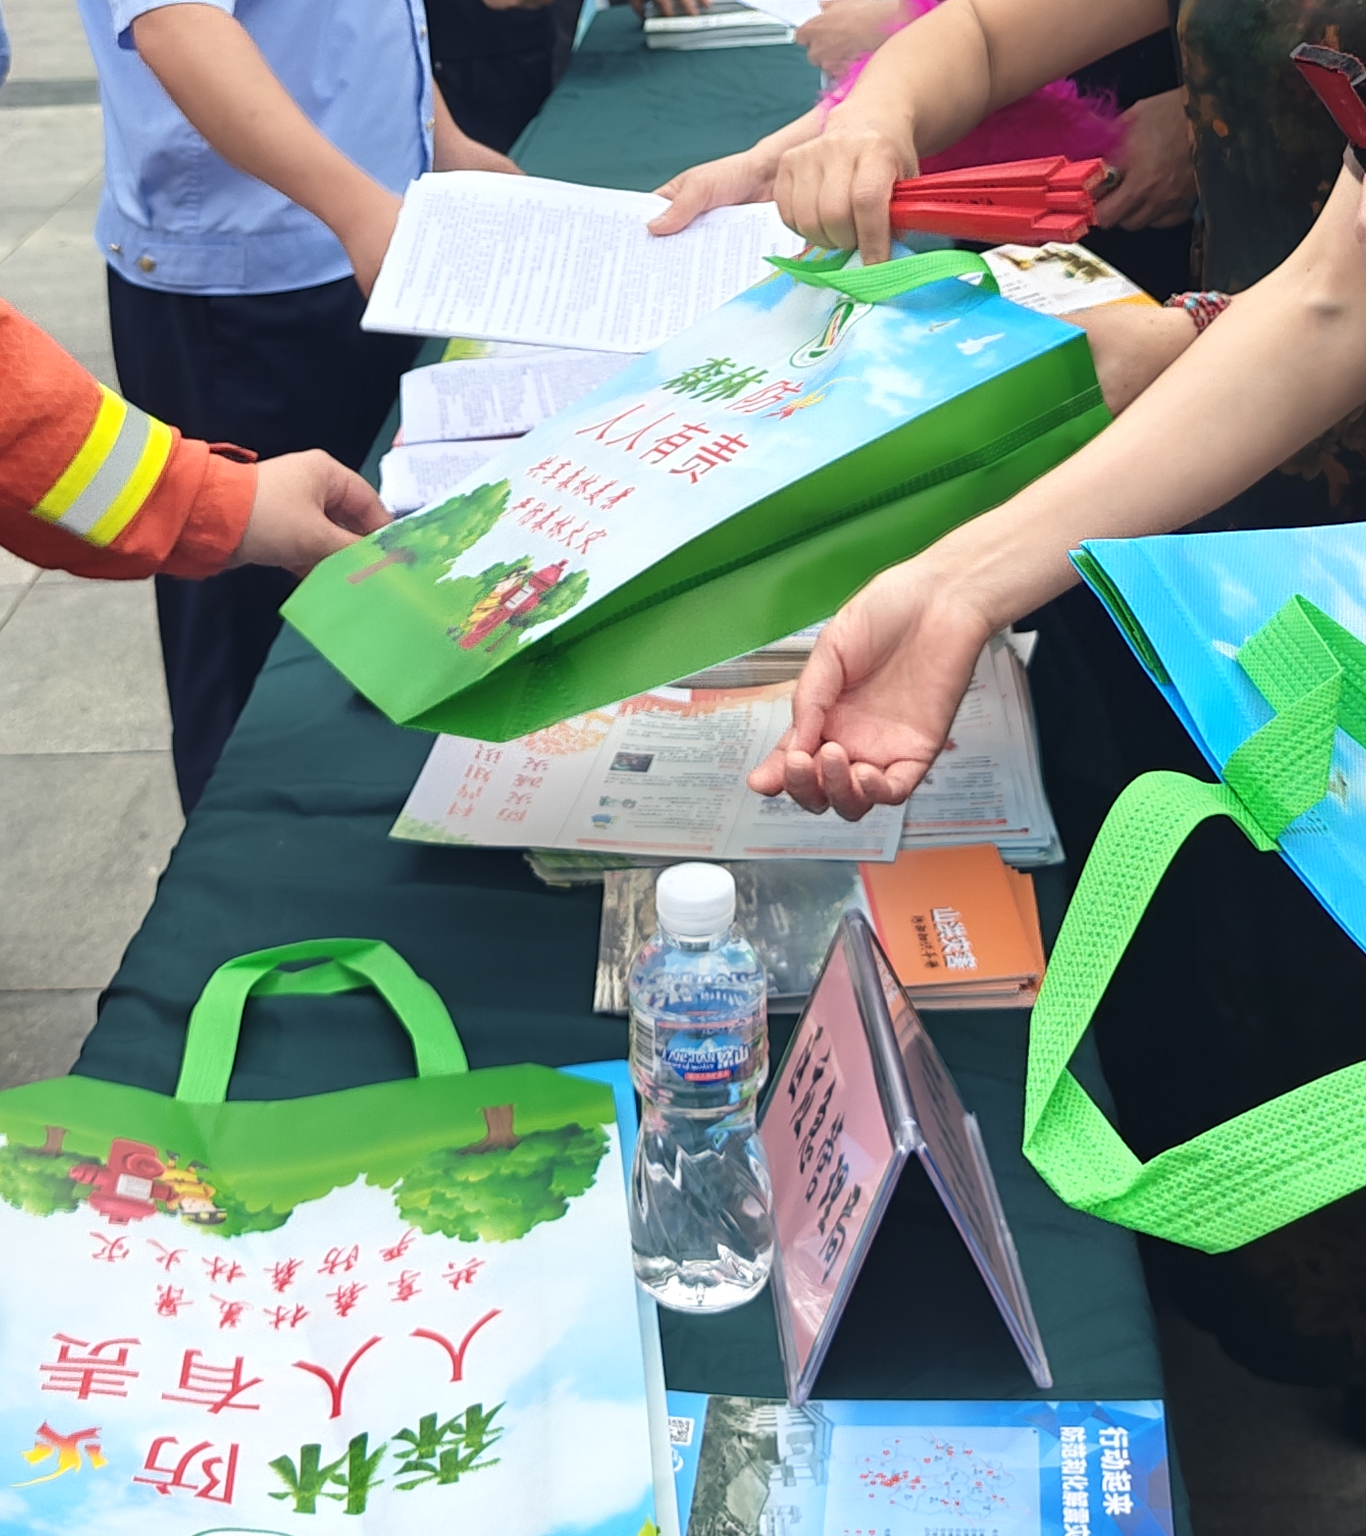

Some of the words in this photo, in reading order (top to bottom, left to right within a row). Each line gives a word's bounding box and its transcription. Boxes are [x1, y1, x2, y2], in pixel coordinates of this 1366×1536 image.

[525, 455, 636, 510] 共享森林美景
[574, 403, 750, 485] 人人有责
[501, 496, 608, 555] 严防森林火灾
[931, 906, 978, 972] 山洪灾害
[787, 1024, 862, 1284] 区应急管理局
[89, 1228, 421, 1295] 严防森林火灾
[155, 1256, 490, 1331] 共享森林美景
[39, 1308, 503, 1420] 人人有责
[9, 1401, 507, 1516] 森林防火
[1098, 1425, 1134, 1517] 行动起来
